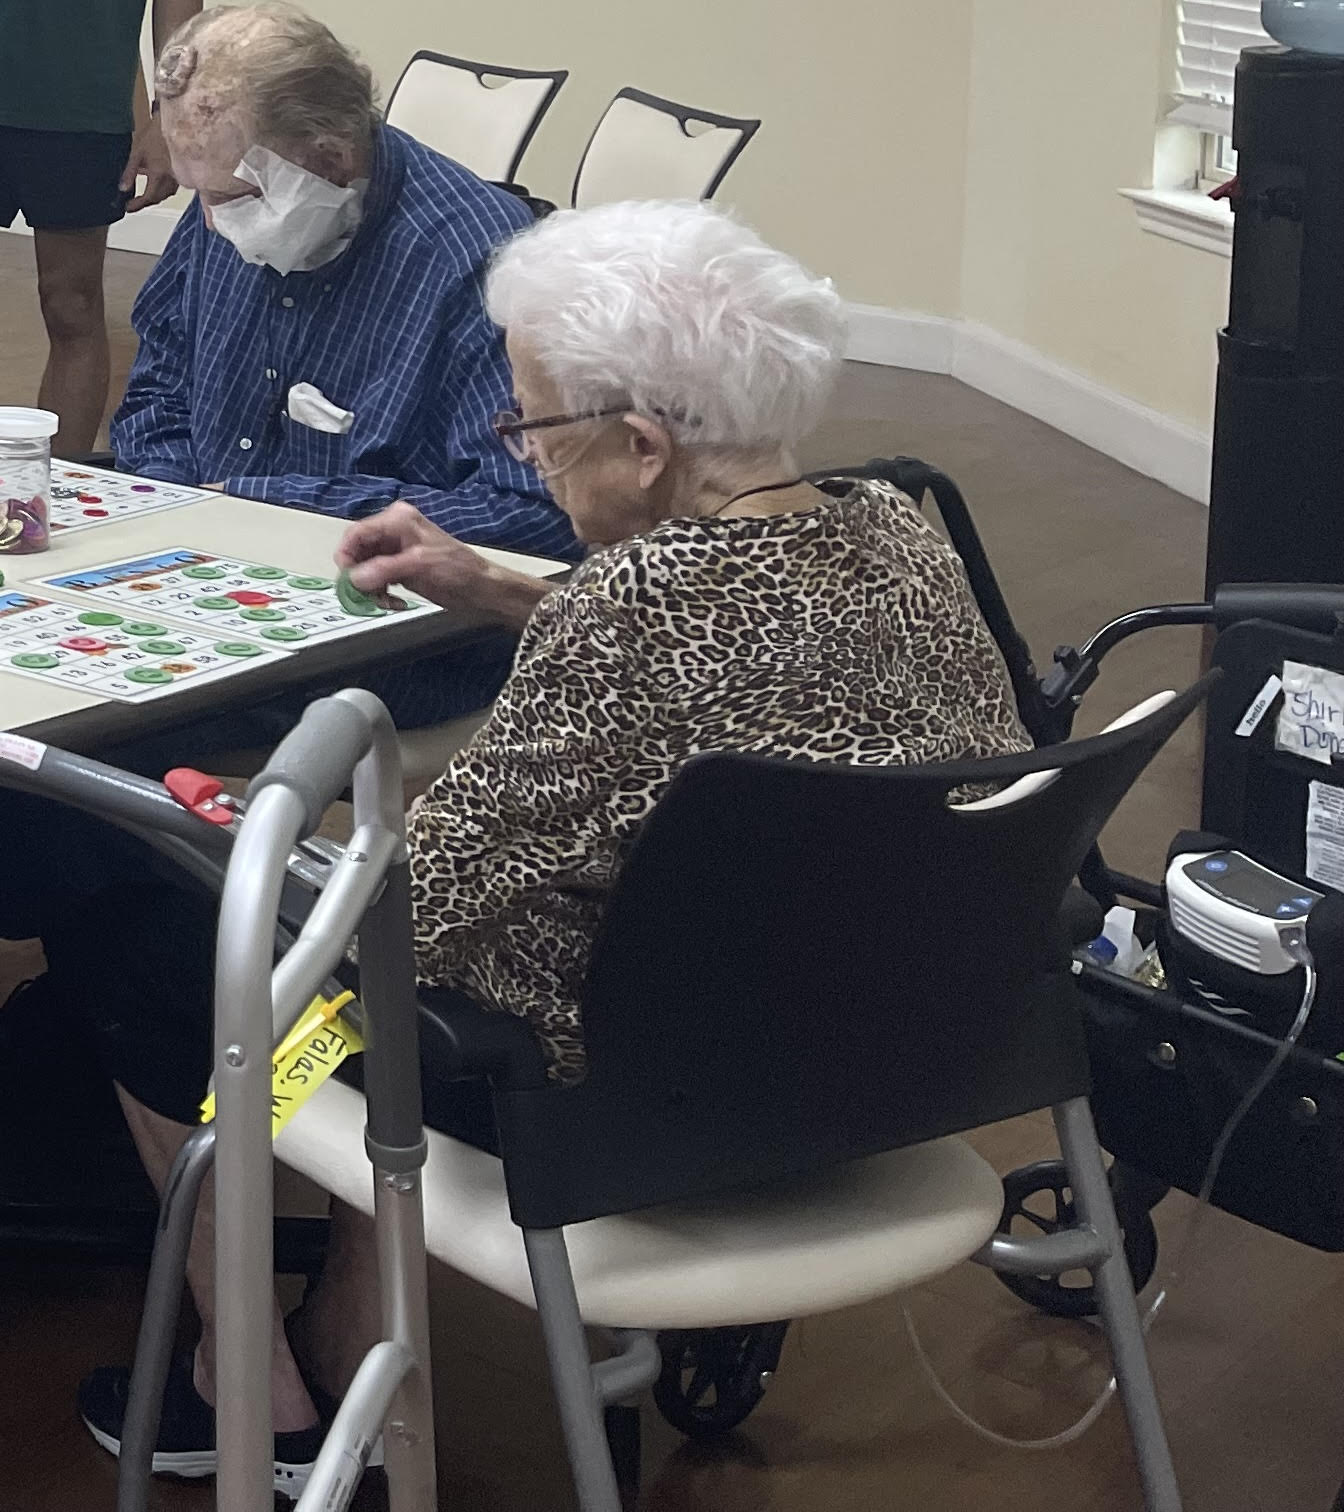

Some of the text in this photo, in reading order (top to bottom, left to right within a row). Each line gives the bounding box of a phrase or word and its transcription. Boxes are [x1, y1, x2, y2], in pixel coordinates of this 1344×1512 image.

[90, 661, 116, 669] 16
[177, 636, 197, 644] 67
[1245, 699, 1267, 726] hello
[1291, 689, 1344, 723] Shir
